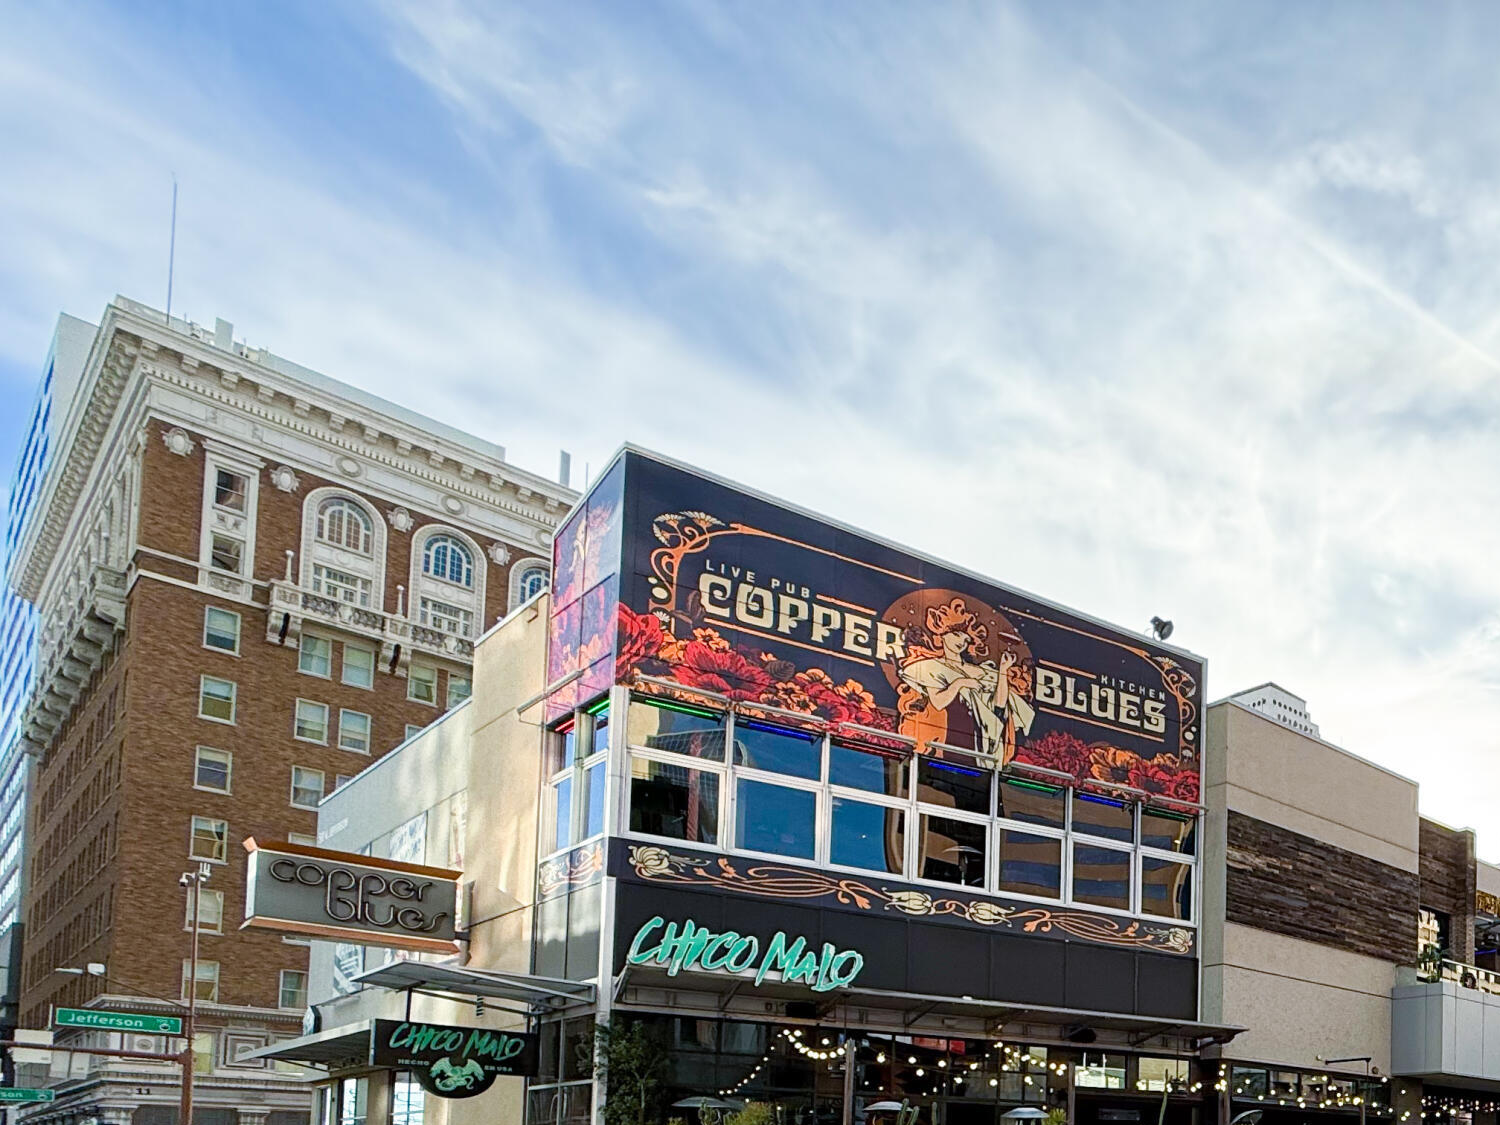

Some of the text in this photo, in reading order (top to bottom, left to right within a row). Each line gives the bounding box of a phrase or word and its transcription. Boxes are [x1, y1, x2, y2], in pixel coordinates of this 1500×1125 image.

[706, 559, 810, 598] LIVE PUB
[698, 572, 905, 661] COPPER
[1035, 666, 1166, 733] BLUES
[1101, 674, 1166, 701] KITCHEN
[627, 915, 758, 976] CHICO
[68, 1013, 143, 1027] Jefferson
[389, 1023, 464, 1054] CHICO
[398, 1058, 430, 1066] HECHO
